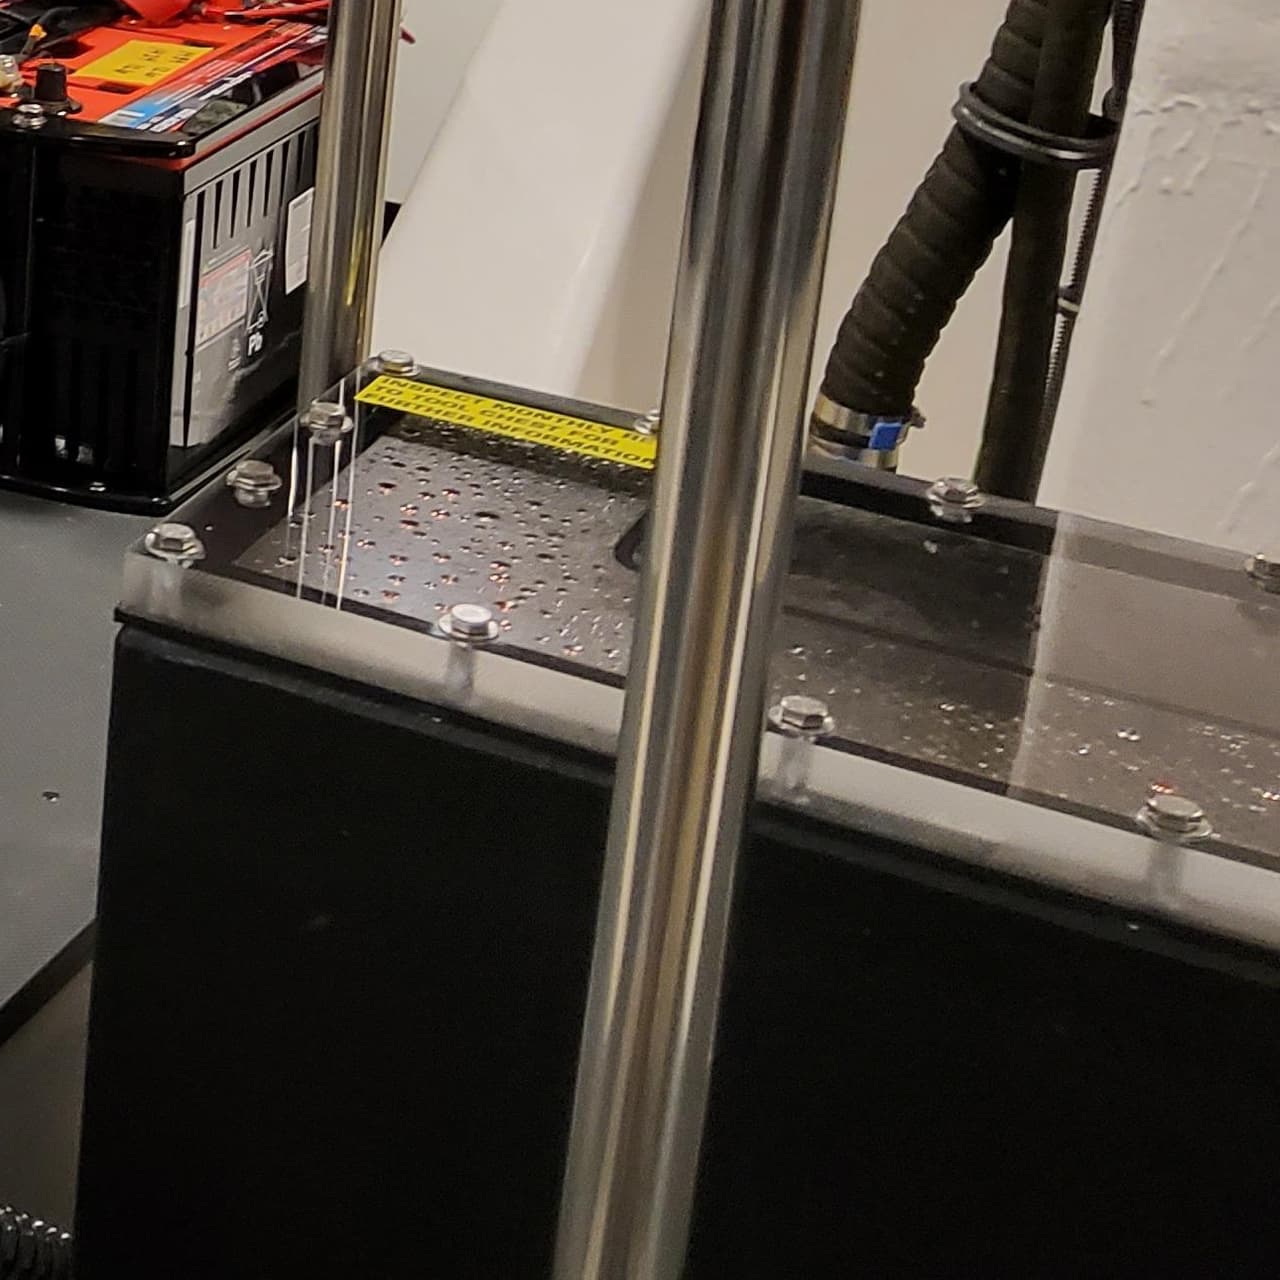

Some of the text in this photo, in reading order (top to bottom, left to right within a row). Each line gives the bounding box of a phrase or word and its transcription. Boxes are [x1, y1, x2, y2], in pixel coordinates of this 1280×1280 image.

[247, 332, 264, 356] Pb
[363, 392, 475, 422] FURTHER
[375, 386, 619, 446] TO TOOL CHEST FOR
[381, 378, 485, 405] INSPECT
[492, 403, 614, 434] MONTHLY
